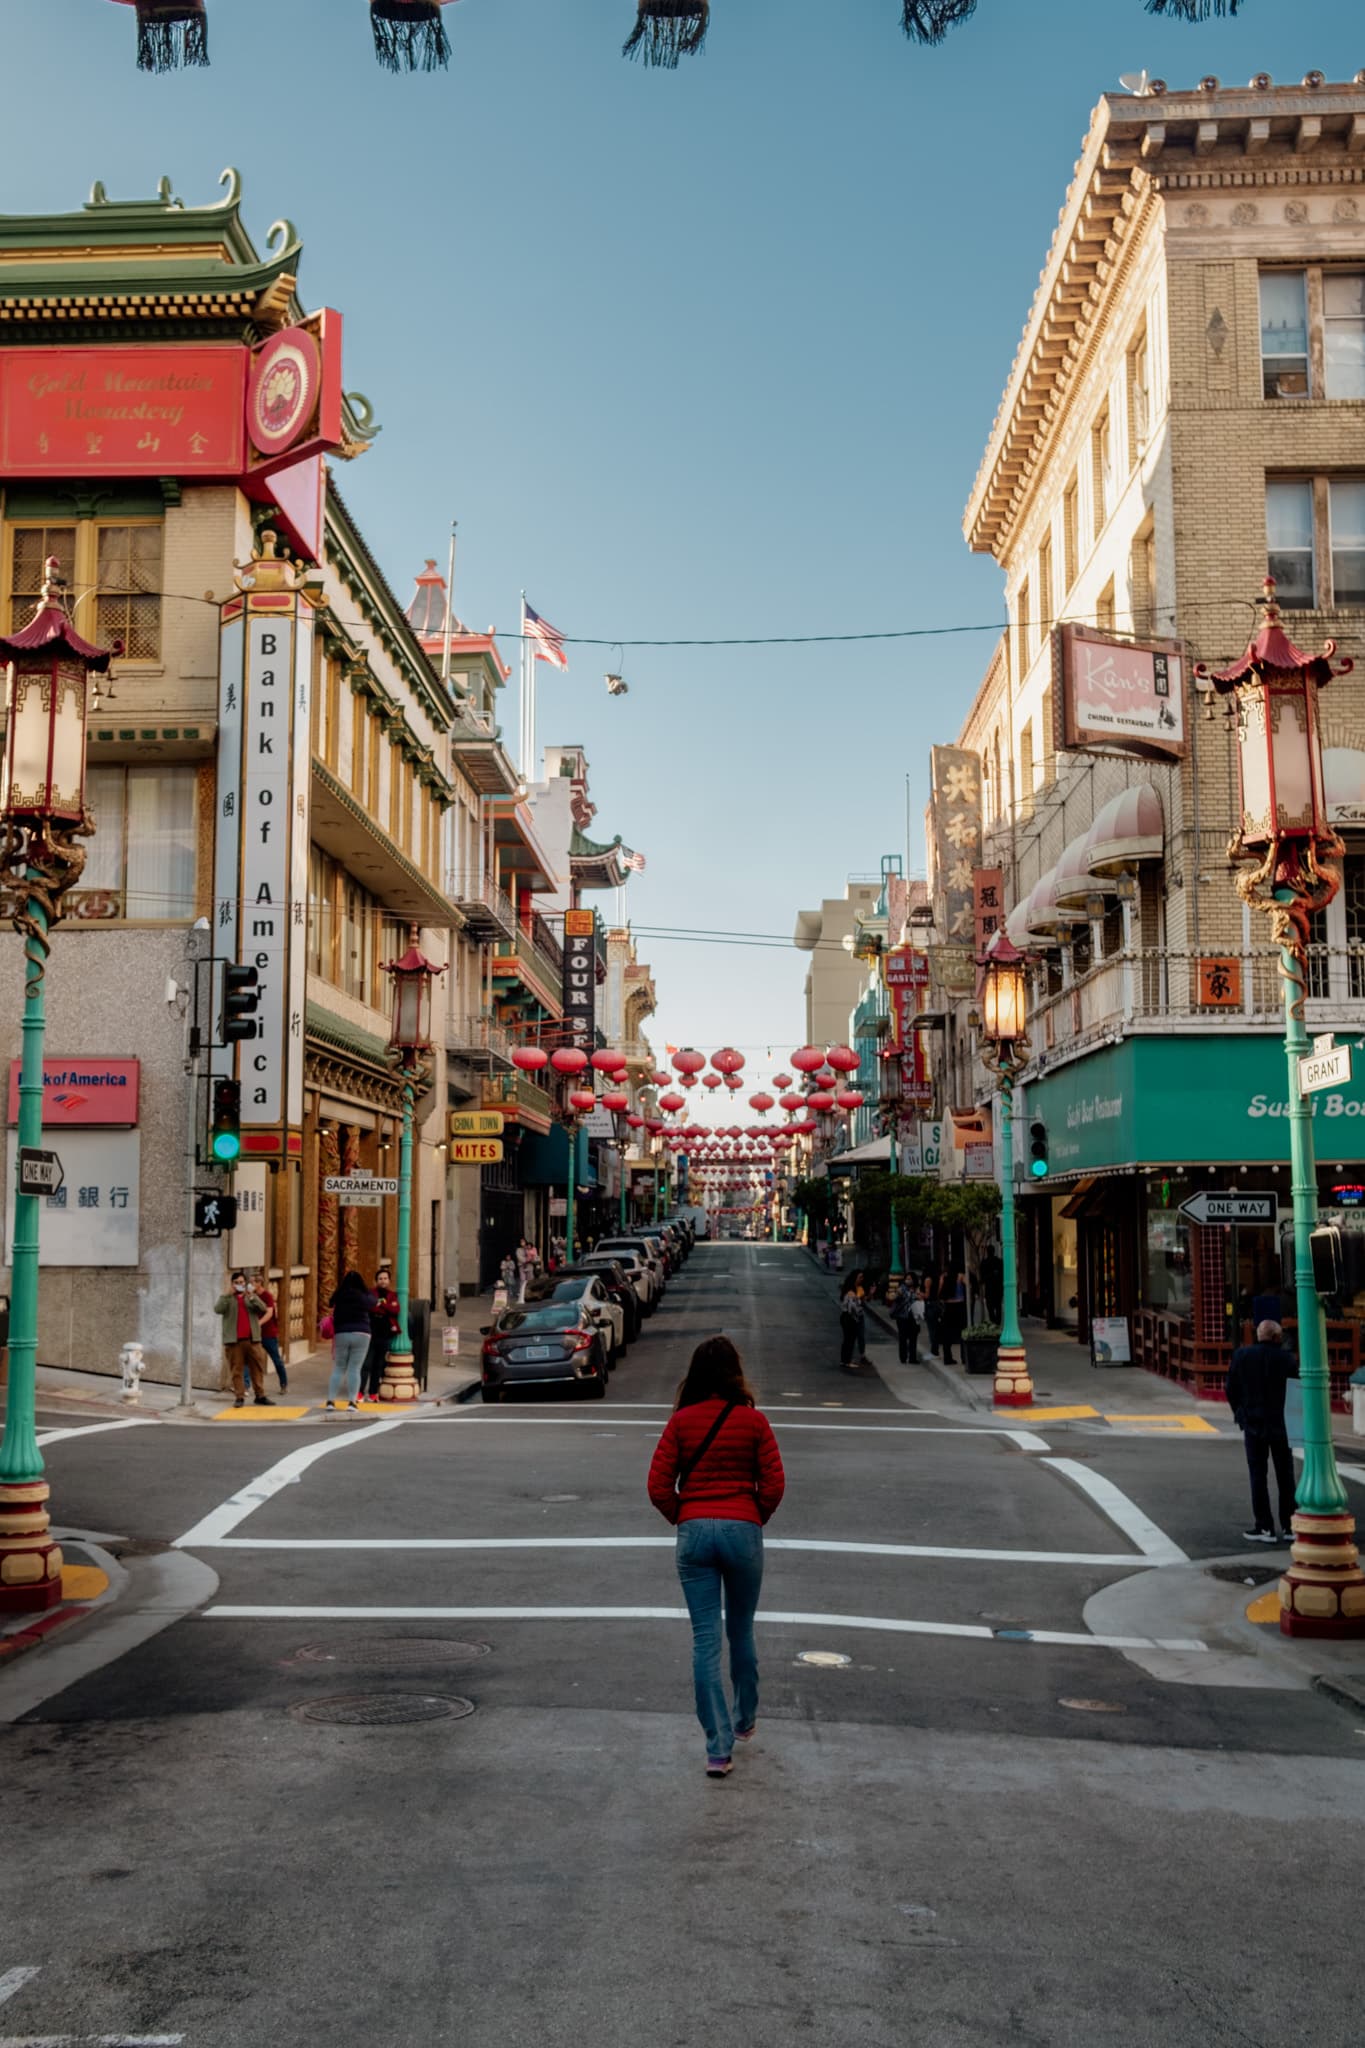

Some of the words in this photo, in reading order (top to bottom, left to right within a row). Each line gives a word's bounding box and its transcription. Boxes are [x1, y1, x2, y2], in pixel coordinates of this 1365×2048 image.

[27, 371, 87, 398] Gold
[96, 370, 214, 393] Mountain
[54, 400, 184, 427] Monastery
[1084, 647, 1150, 699] Kan's
[259, 633, 277, 754] Bank
[258, 789, 275, 844] of
[570, 938, 589, 1005] FOUR
[251, 882, 275, 1104] America
[53, 1072, 67, 1086] of
[69, 1072, 127, 1087] America
[1307, 1056, 1340, 1083] GRANT
[454, 1117, 474, 1130] CHINA
[479, 1116, 499, 1130] TOWN
[455, 1143, 496, 1158] KITES
[25, 1162, 38, 1180] ONE
[40, 1165, 54, 1182] WAY
[326, 1180, 397, 1192] SACRAMENTO
[1207, 1202, 1234, 1214] ONE
[1238, 1202, 1265, 1214] WAY
[1345, 1211, 1365, 1220] FO
